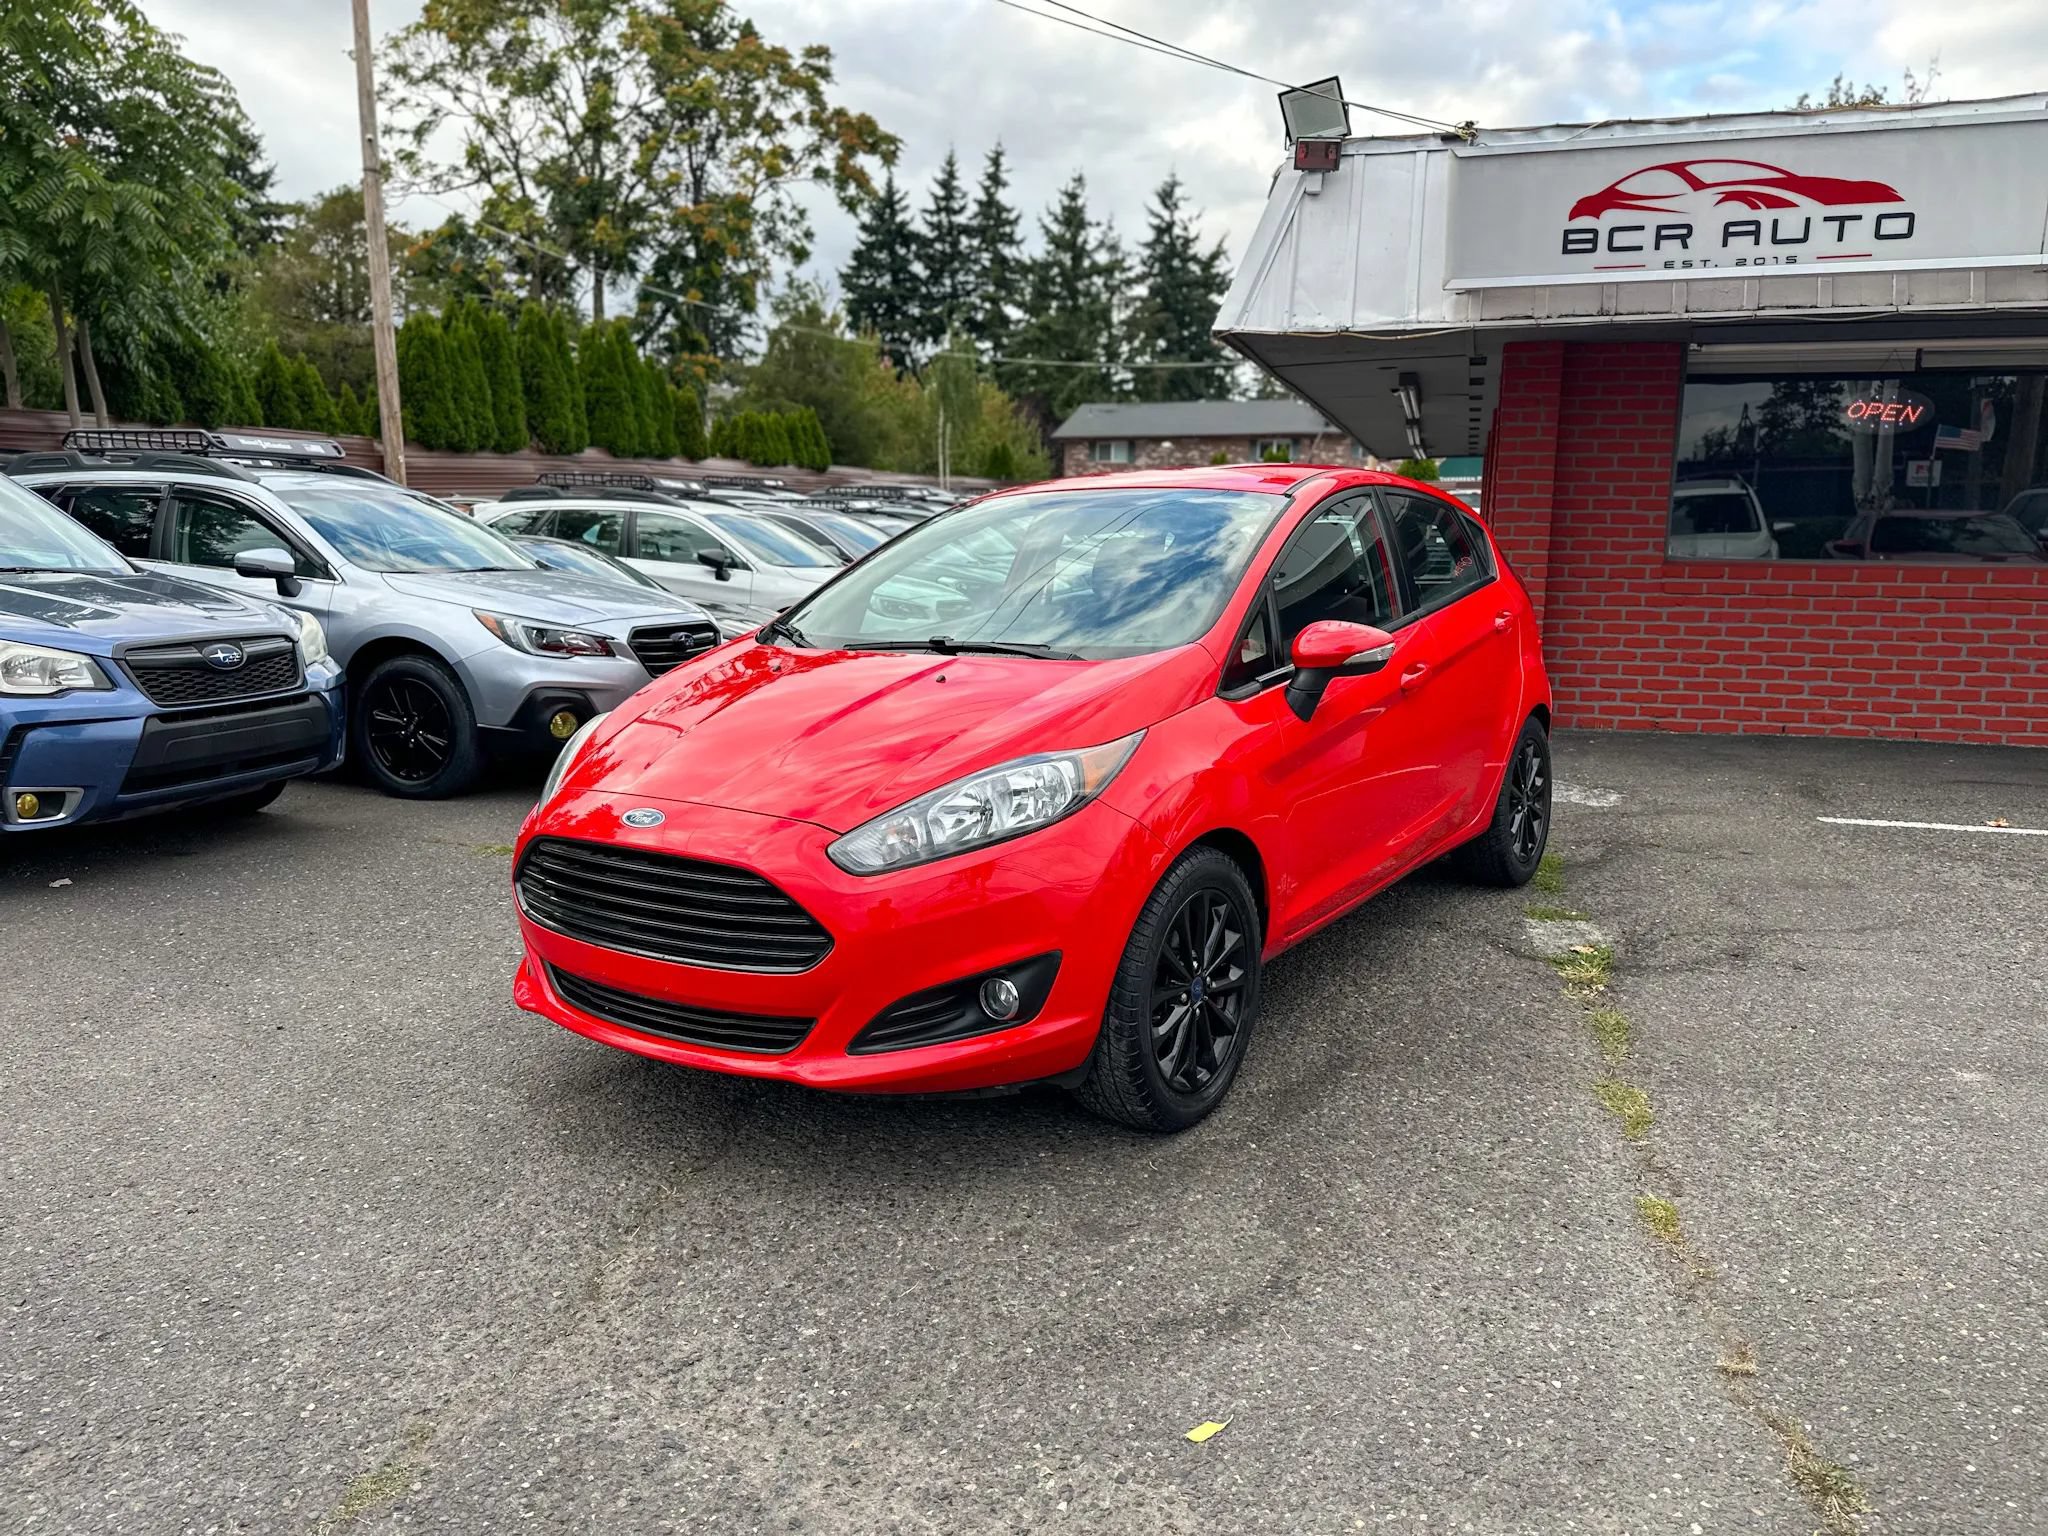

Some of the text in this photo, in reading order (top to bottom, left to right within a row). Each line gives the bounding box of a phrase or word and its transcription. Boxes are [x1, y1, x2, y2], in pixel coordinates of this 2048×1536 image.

[1562, 212, 1915, 254] BCR AUTO
[1664, 255, 1798, 269] EST. 2015
[1847, 402, 1923, 423] OPEN
[627, 810, 658, 824] Ford
